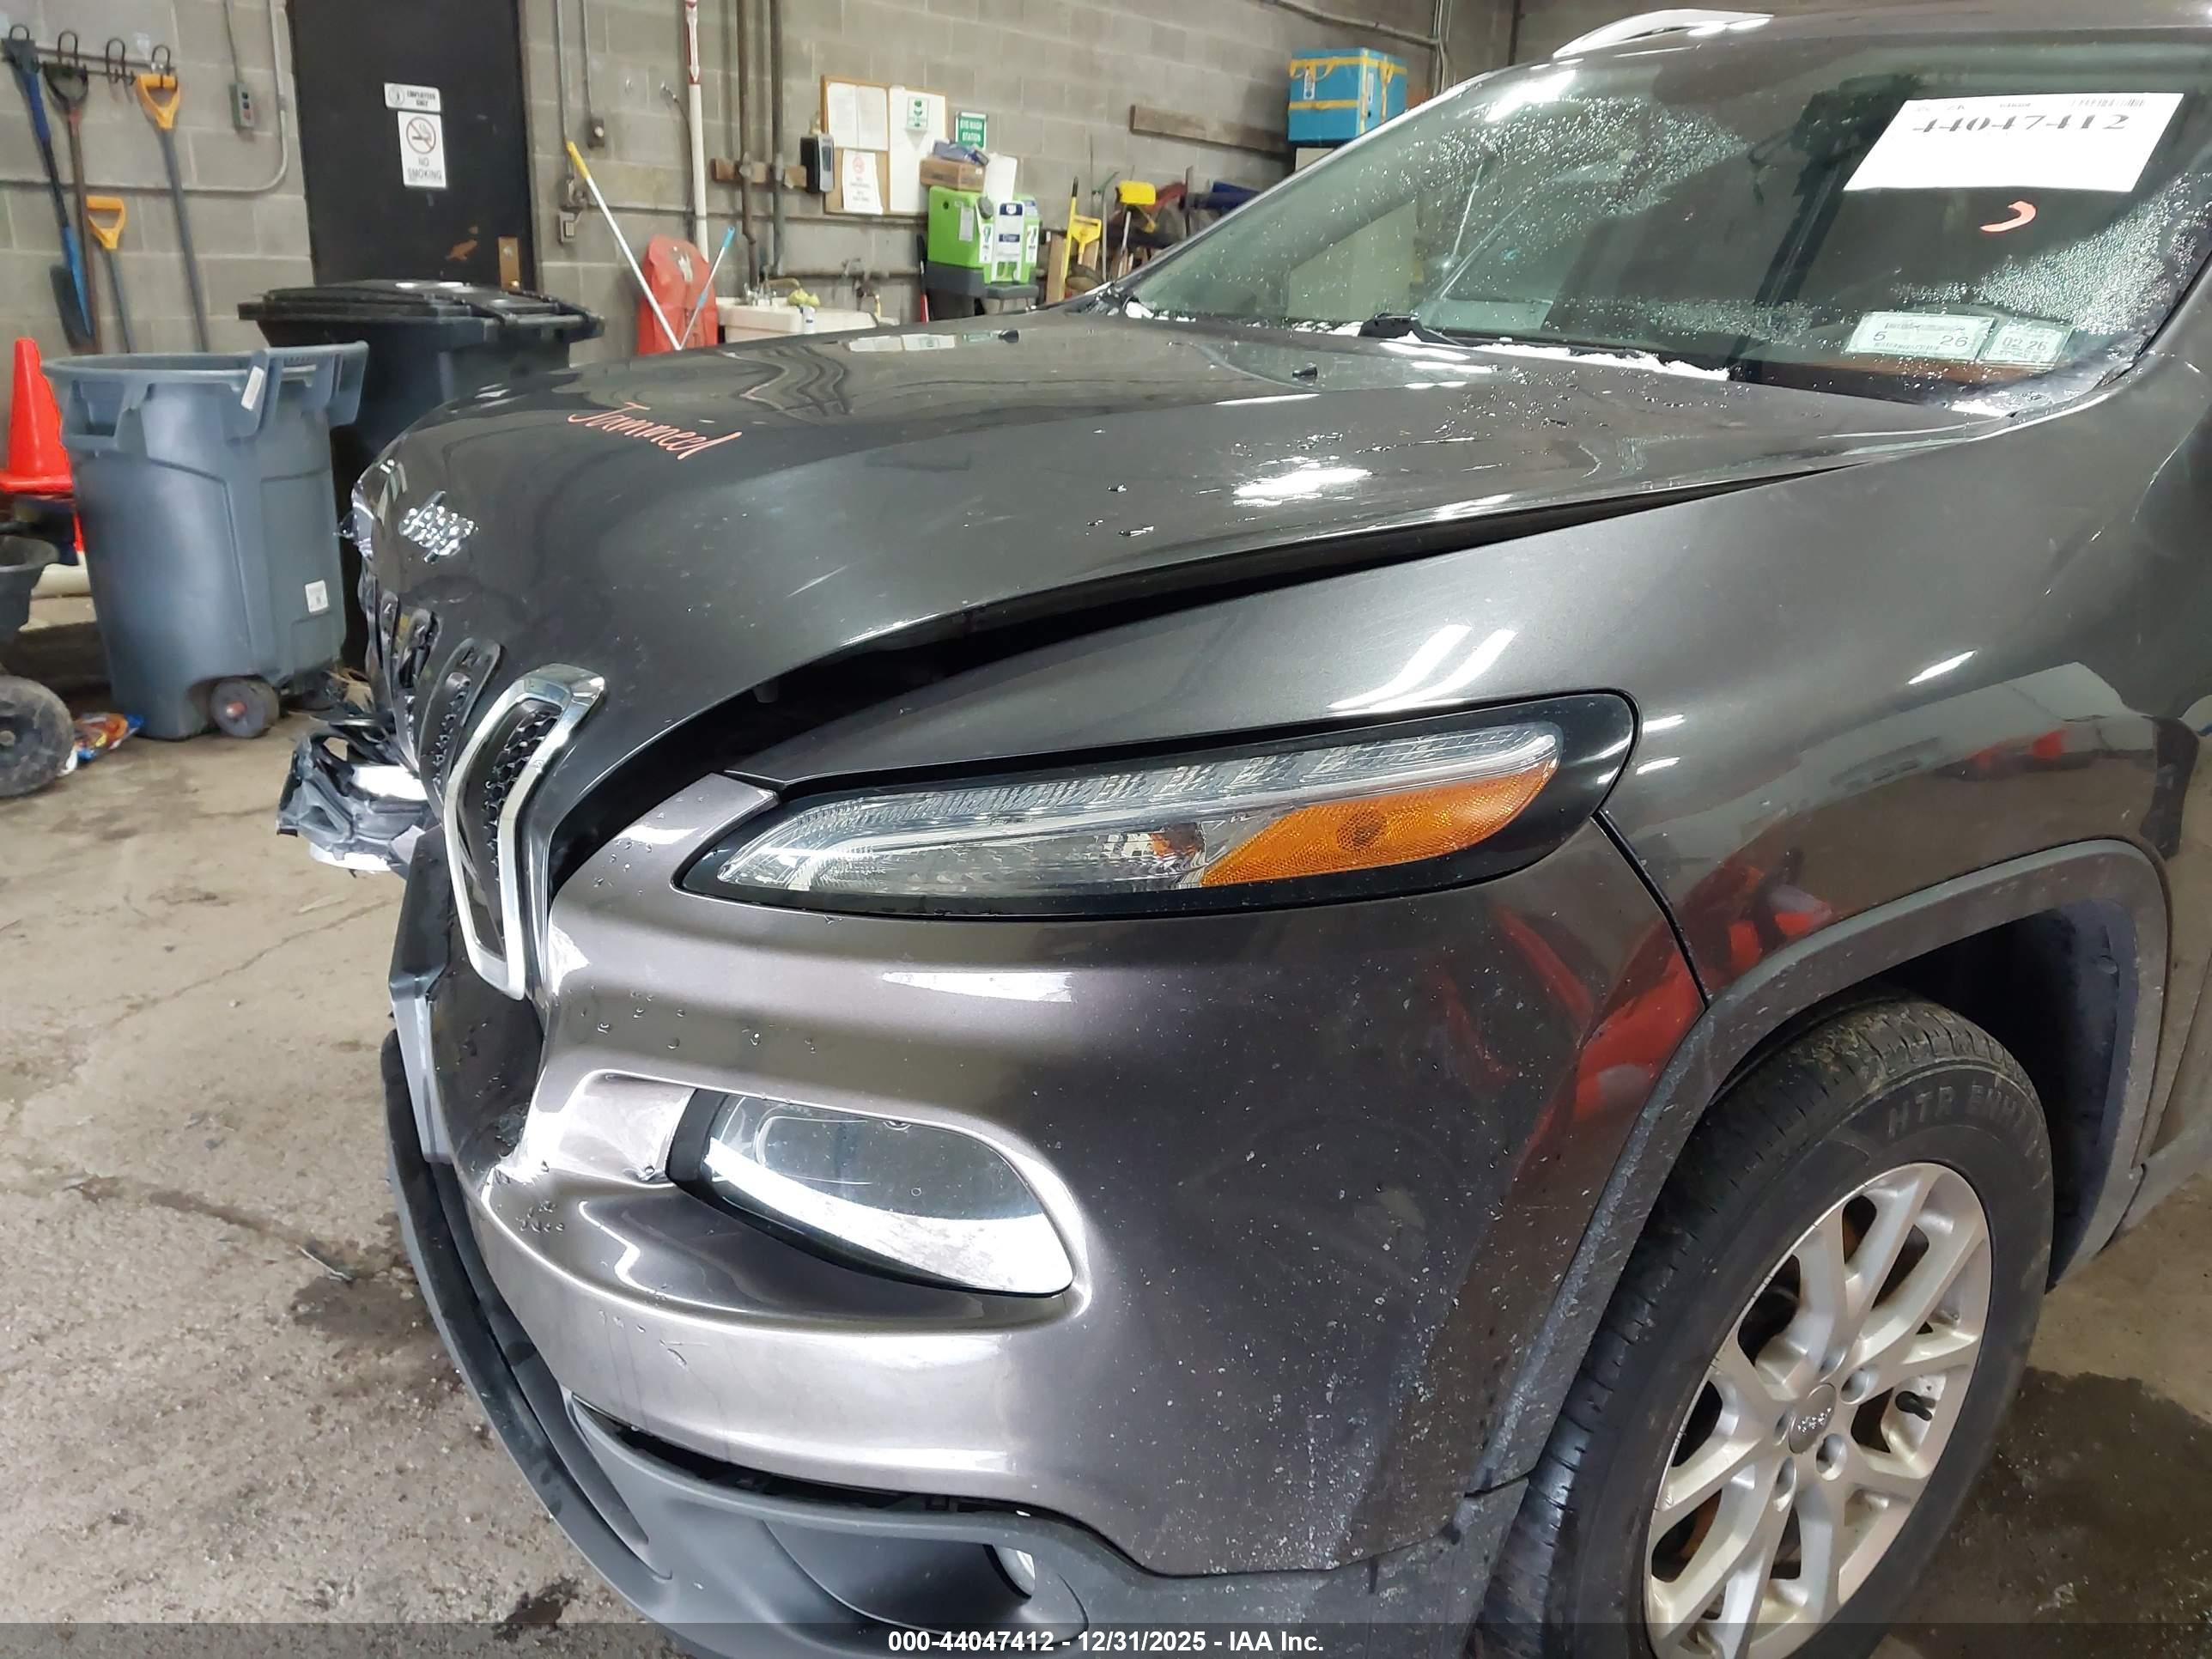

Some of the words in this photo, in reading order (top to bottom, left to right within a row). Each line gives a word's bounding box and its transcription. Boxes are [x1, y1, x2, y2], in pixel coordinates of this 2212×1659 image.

[1912, 114, 2130, 132] 44047412
[418, 157, 429, 167] NO
[407, 168, 442, 181] SMOKING
[1940, 336, 1969, 348] 26
